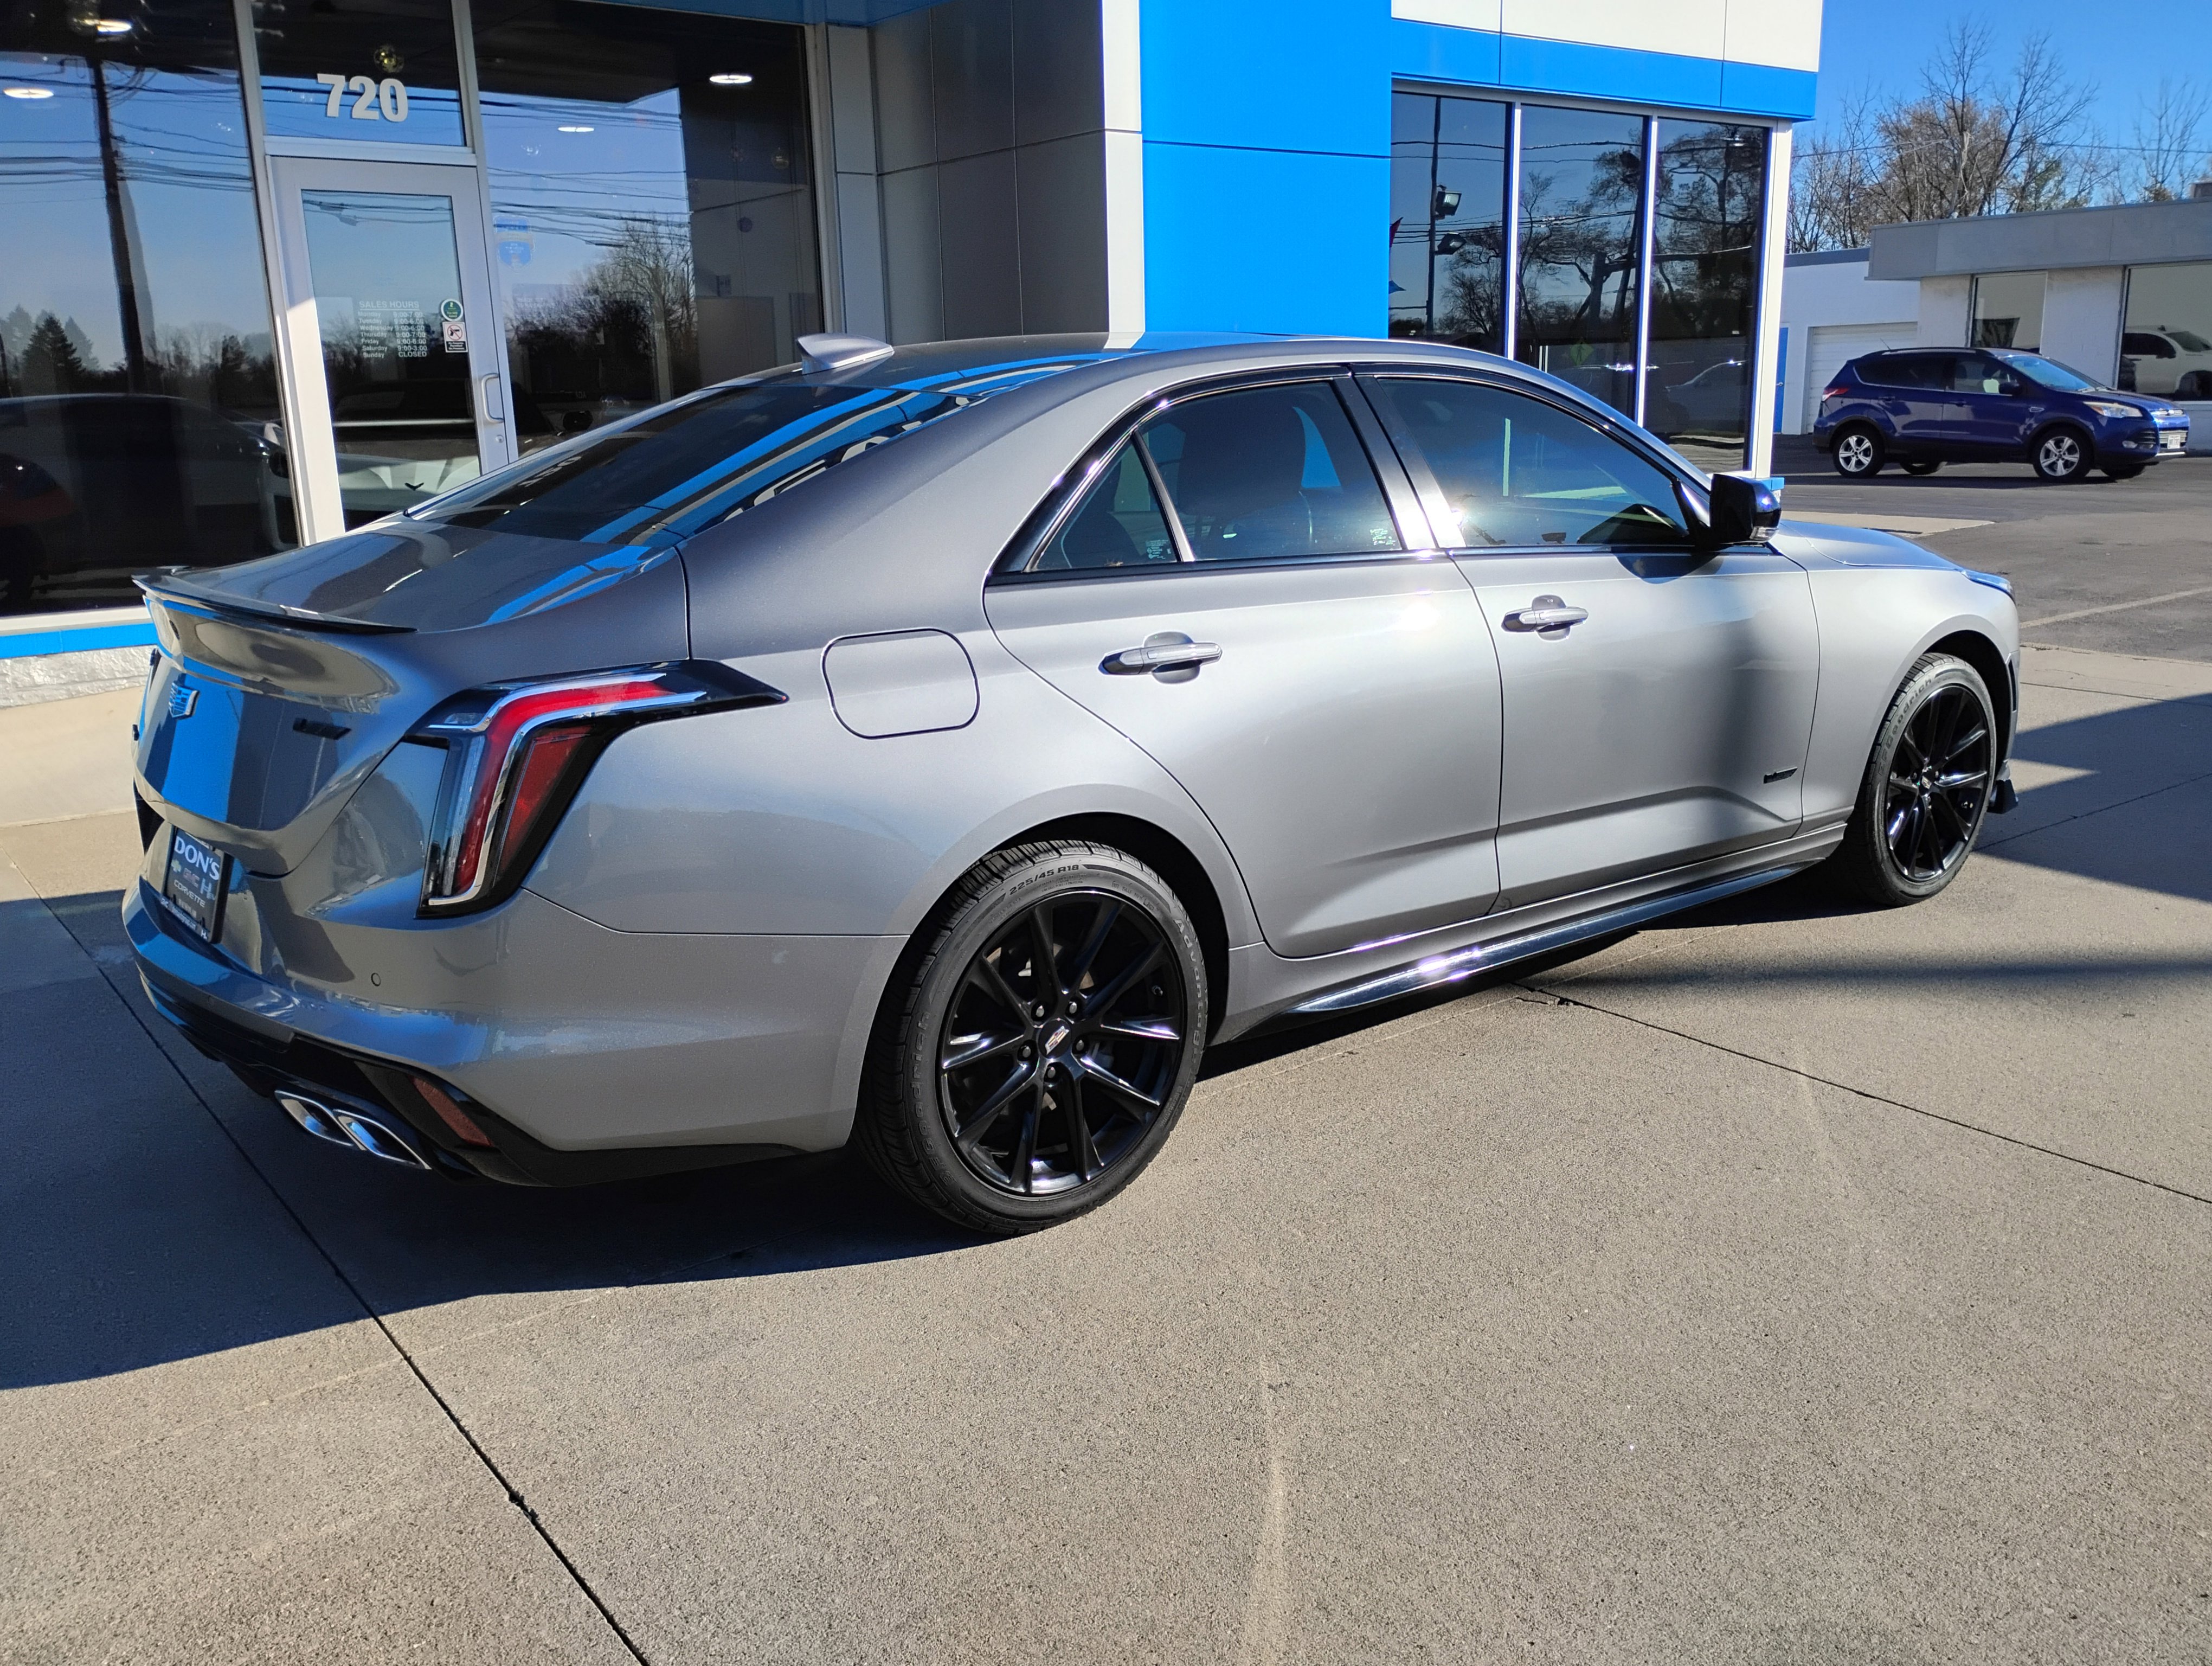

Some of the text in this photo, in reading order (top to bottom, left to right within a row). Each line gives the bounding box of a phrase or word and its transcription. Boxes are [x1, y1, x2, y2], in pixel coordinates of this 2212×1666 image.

[317, 73, 408, 123] 720
[175, 835, 220, 880] DON'S
[1009, 869, 1055, 895] 225/45
[1057, 864, 1079, 874] R18
[173, 879, 206, 908] CORVETTE
[910, 1011, 958, 1188] BFGoodrich
